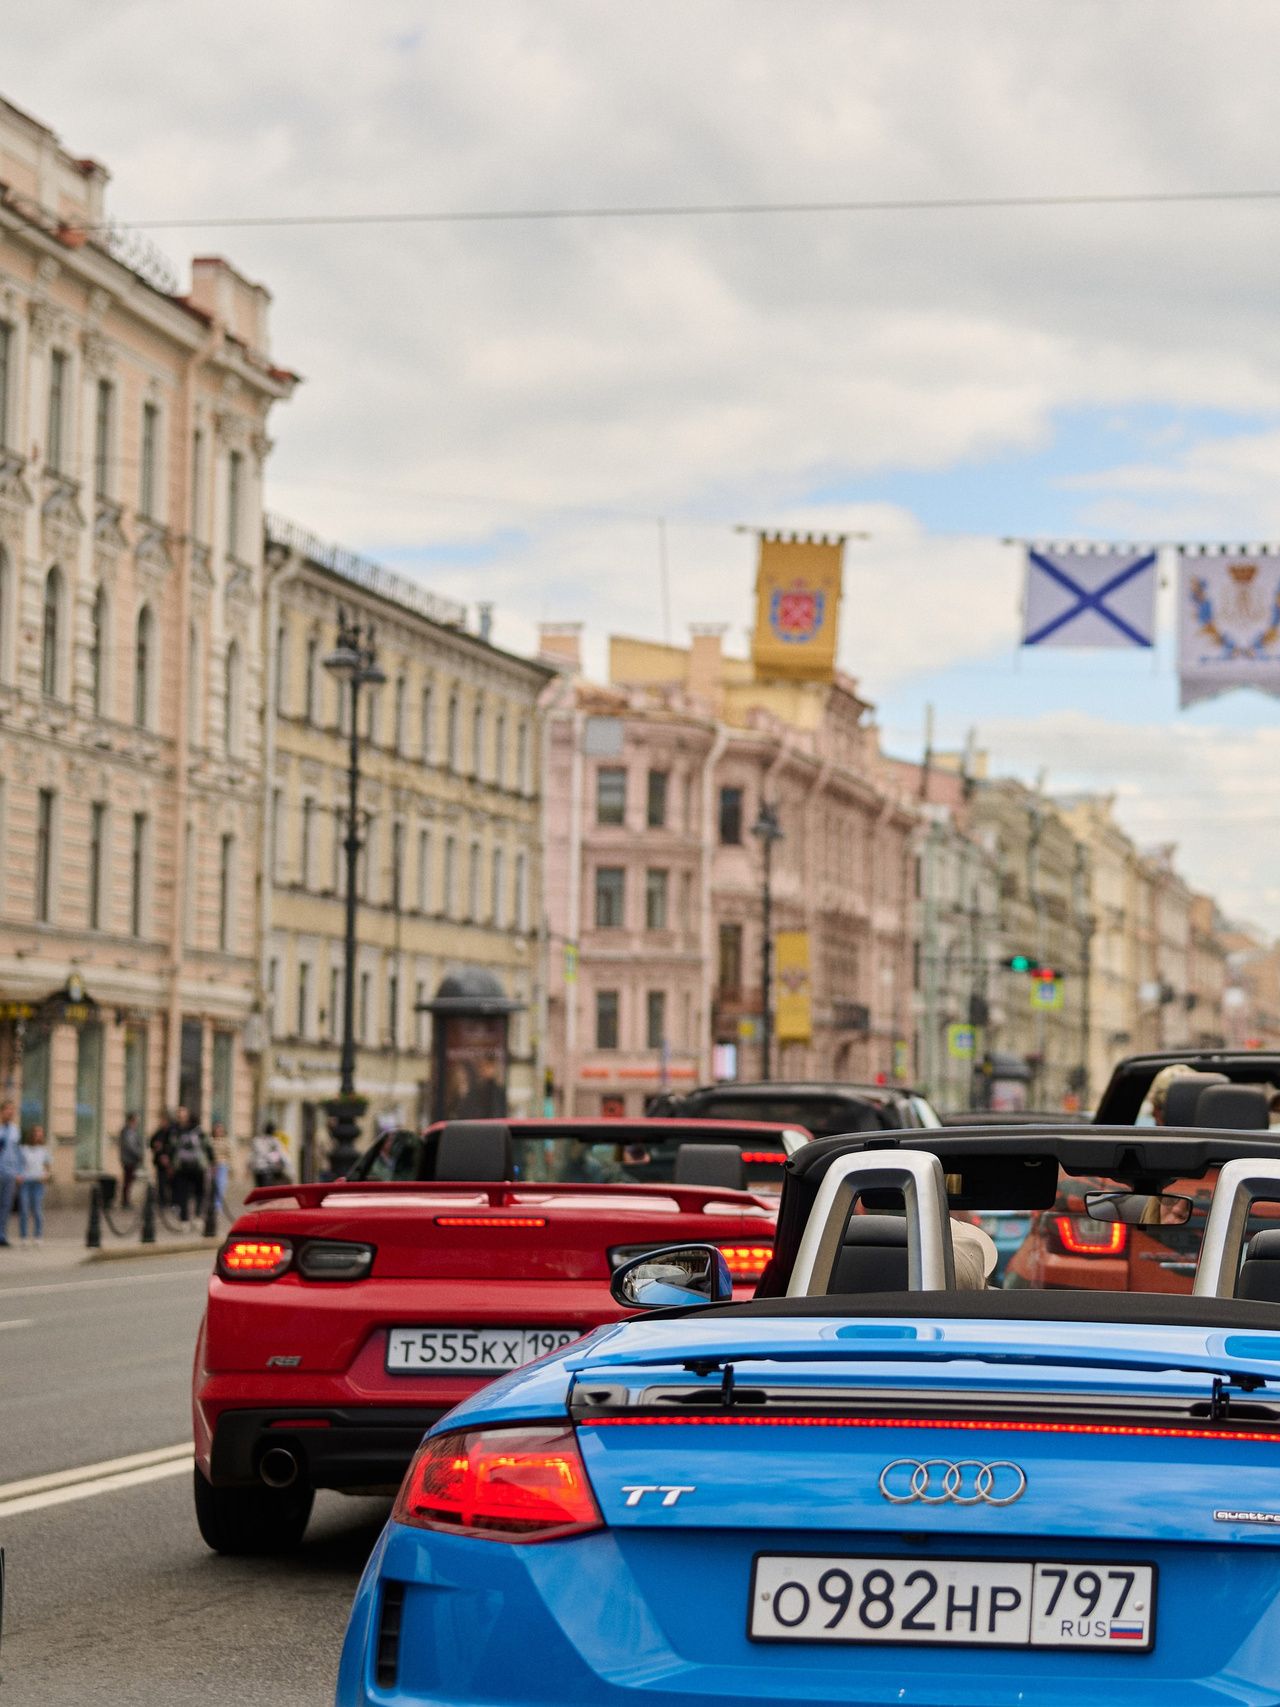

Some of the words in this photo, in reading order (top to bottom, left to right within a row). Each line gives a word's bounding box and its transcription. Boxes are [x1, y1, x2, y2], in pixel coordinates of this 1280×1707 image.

[621, 1485, 697, 1507] TT
[772, 1568, 1022, 1632] О982НР
[1040, 1569, 1135, 1618] 797
[1061, 1620, 1107, 1638] RUS
